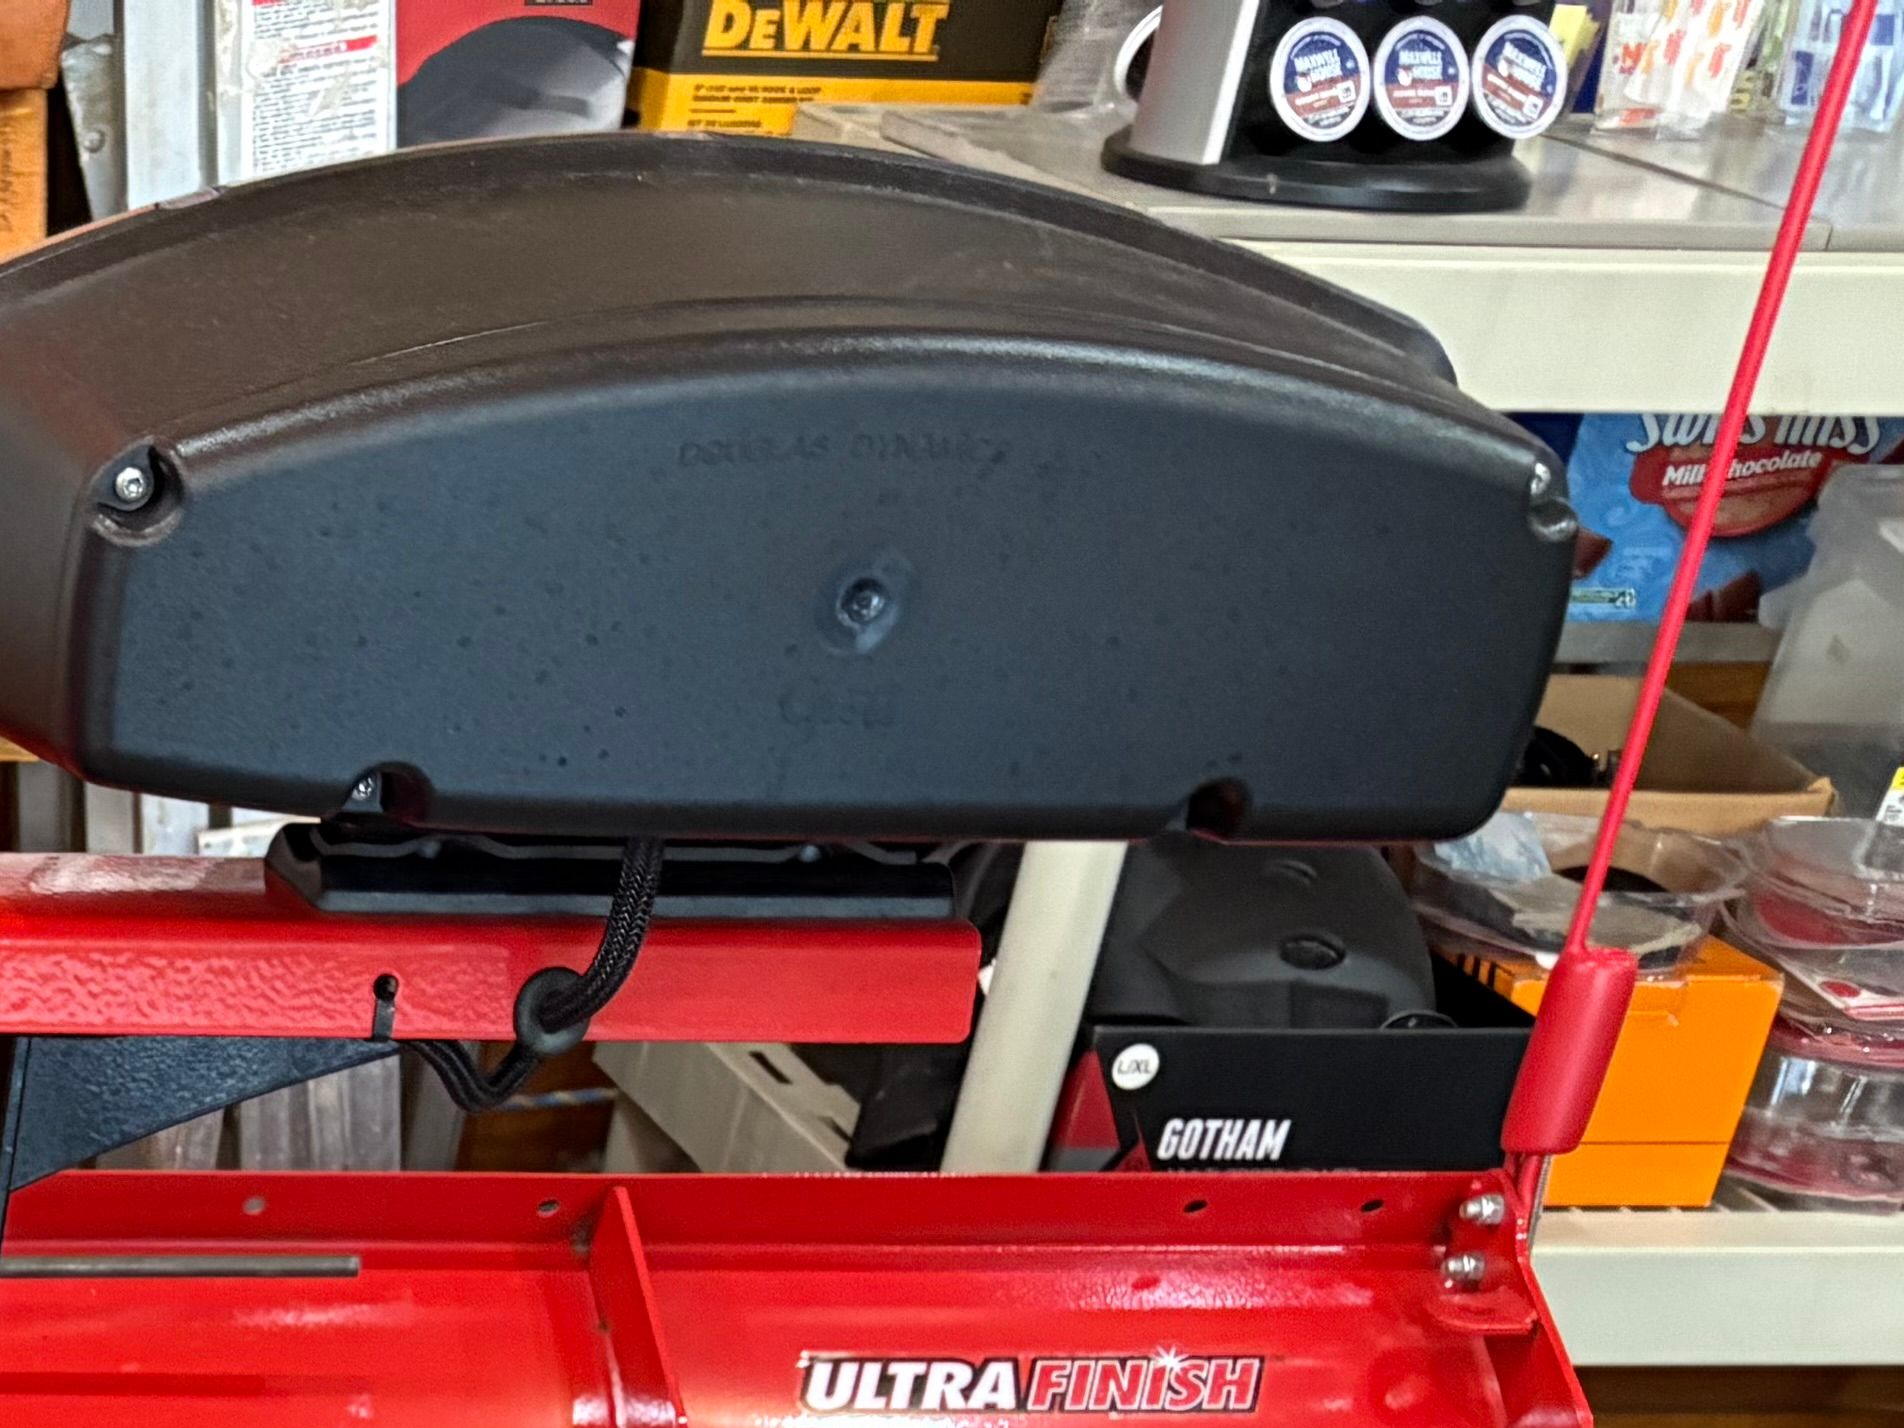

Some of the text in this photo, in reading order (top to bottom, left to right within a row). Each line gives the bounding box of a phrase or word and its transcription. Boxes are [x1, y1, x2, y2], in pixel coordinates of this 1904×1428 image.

[1726, 451, 1823, 480] hocolate
[1156, 1118, 1292, 1160] GOTHAM
[805, 1359, 1258, 1411] ULTRA FINISH
